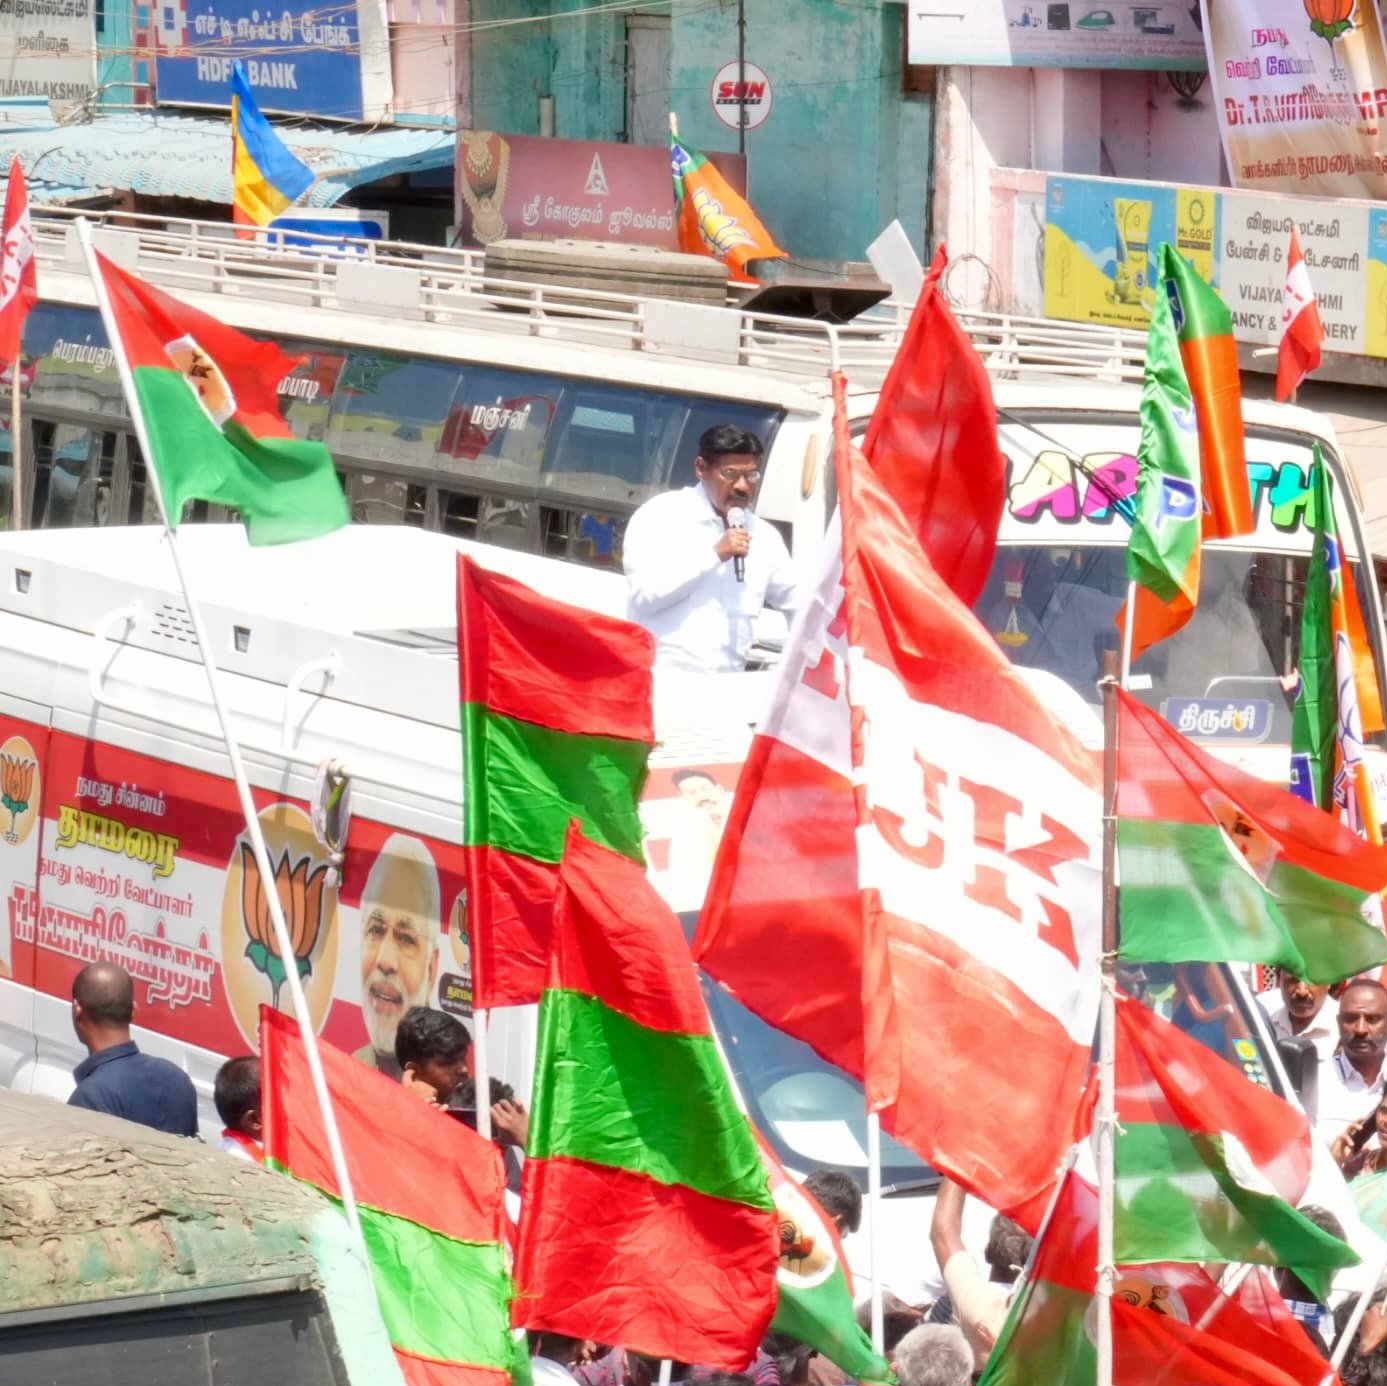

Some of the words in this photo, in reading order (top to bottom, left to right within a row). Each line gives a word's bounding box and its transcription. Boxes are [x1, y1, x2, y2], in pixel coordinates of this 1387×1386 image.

[197, 57, 234, 83] HDF
[248, 60, 298, 90] BANK
[0, 79, 90, 100] IJAYALAKSHMI
[544, 197, 604, 228] கோகுலம்
[1190, 228, 1212, 241] GOLD
[1226, 240, 1270, 261] பேன்சி
[1273, 247, 1283, 262] &
[1229, 311, 1265, 329] ANCY
[1268, 316, 1278, 331] &
[76, 776, 113, 808] நமது
[115, 780, 167, 817] சின்னம்
[55, 804, 181, 881] தாமரை
[75, 866, 121, 899] வெற்றி
[124, 878, 195, 919] வேட்பாளர்
